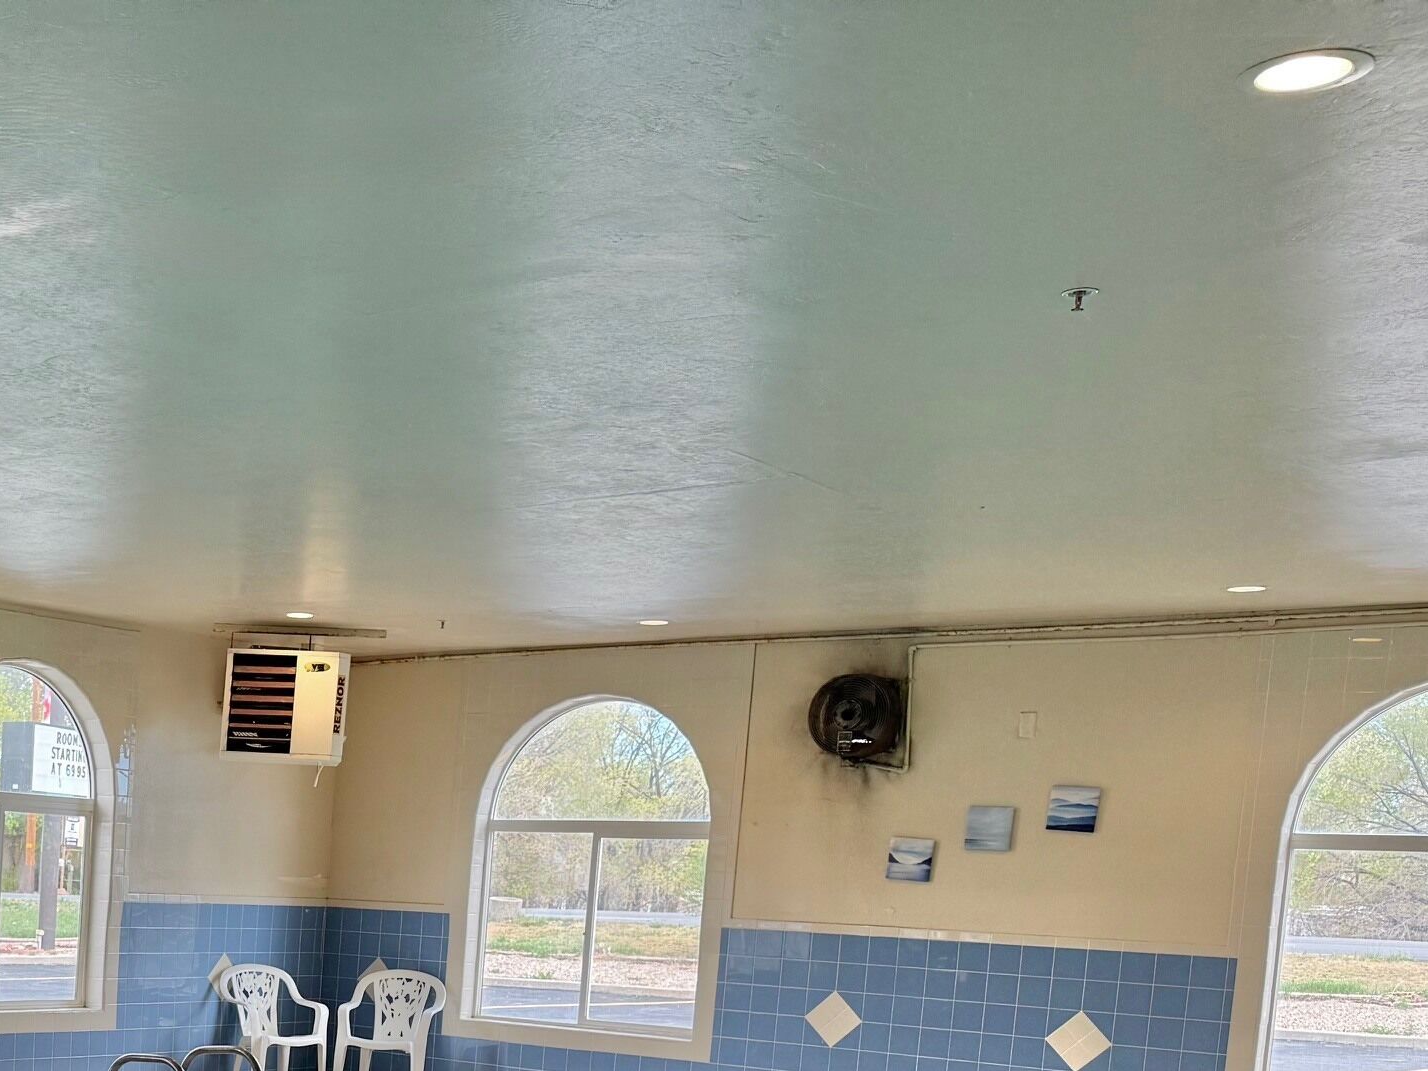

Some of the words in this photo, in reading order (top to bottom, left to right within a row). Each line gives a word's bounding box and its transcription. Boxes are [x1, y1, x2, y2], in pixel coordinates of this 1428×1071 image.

[333, 676, 346, 734] REZNOR
[57, 732, 82, 748] ROOM
[50, 762, 62, 776] AT
